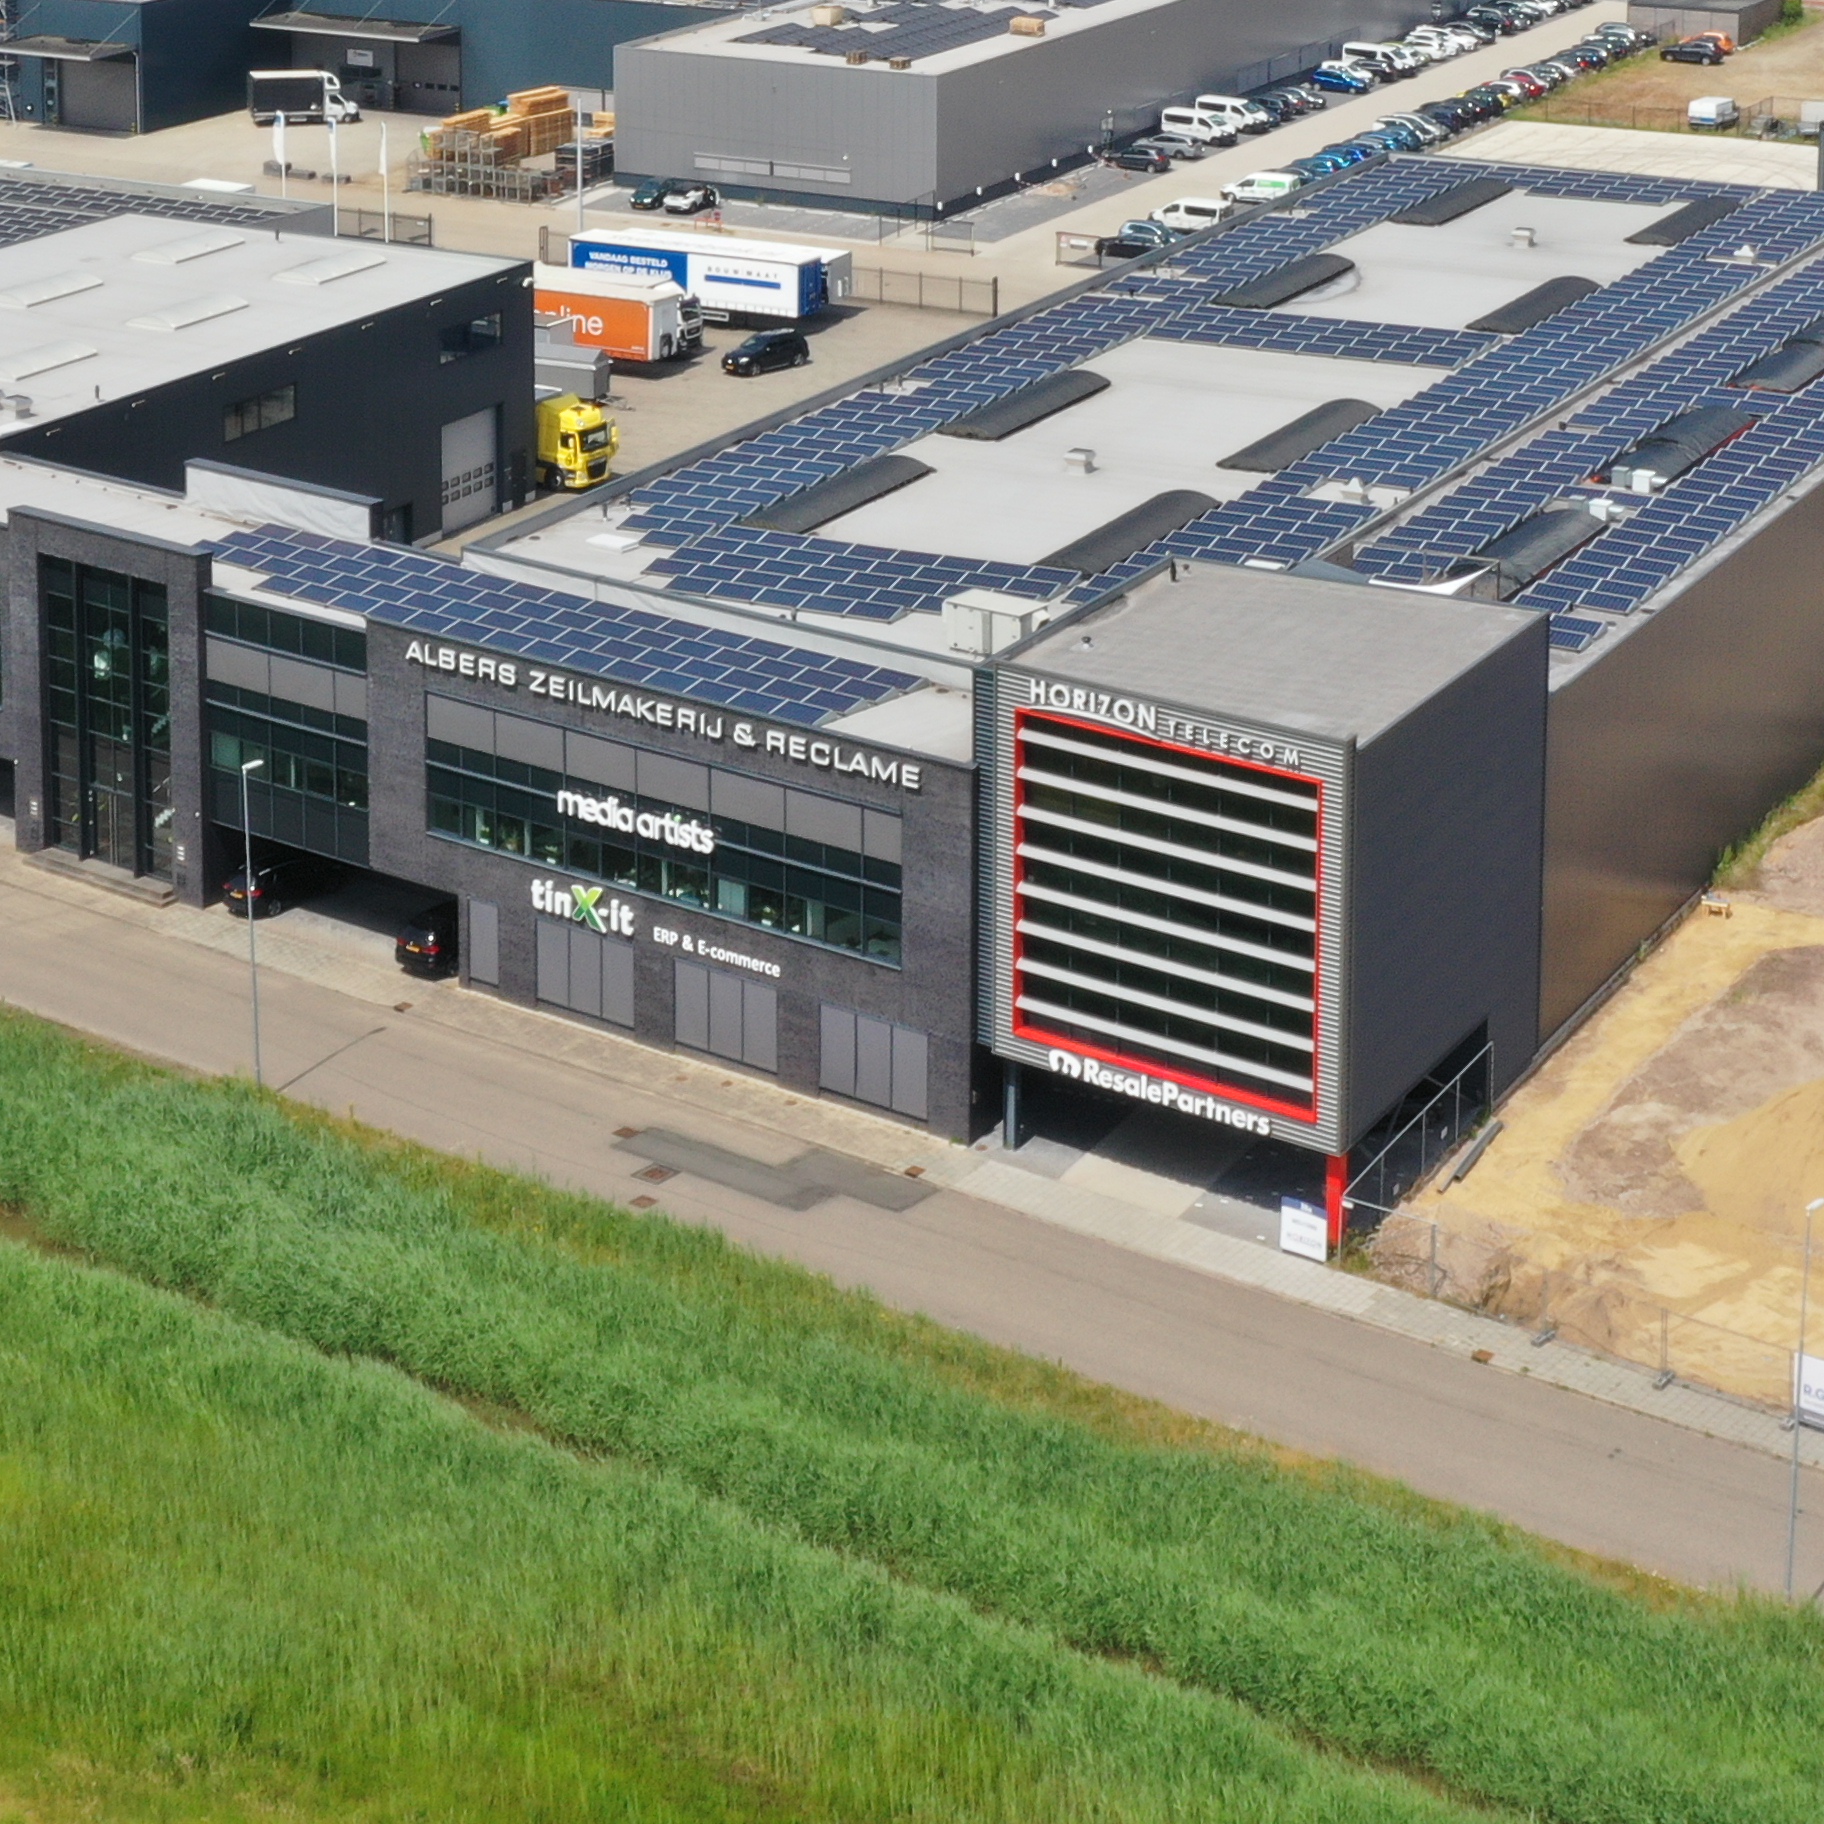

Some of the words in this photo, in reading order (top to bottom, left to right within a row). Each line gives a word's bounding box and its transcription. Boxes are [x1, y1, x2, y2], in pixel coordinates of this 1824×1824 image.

[589, 252, 628, 264] VANDAAG
[629, 256, 668, 268] BESTELD
[405, 640, 517, 686] ALBERS
[528, 670, 723, 738] ZEILMAKERIJ
[733, 722, 758, 747] &
[766, 729, 921, 789] RECLAME
[1029, 677, 1157, 732] HORIZON
[1168, 720, 1299, 766] TELECOM
[557, 789, 635, 834] media
[636, 811, 715, 855] artists
[530, 878, 635, 936] tinX-it
[653, 926, 679, 946] ERP
[682, 934, 694, 952] &
[697, 939, 782, 977] E-commerce
[1083, 1057, 1271, 1136] ResalePartners
